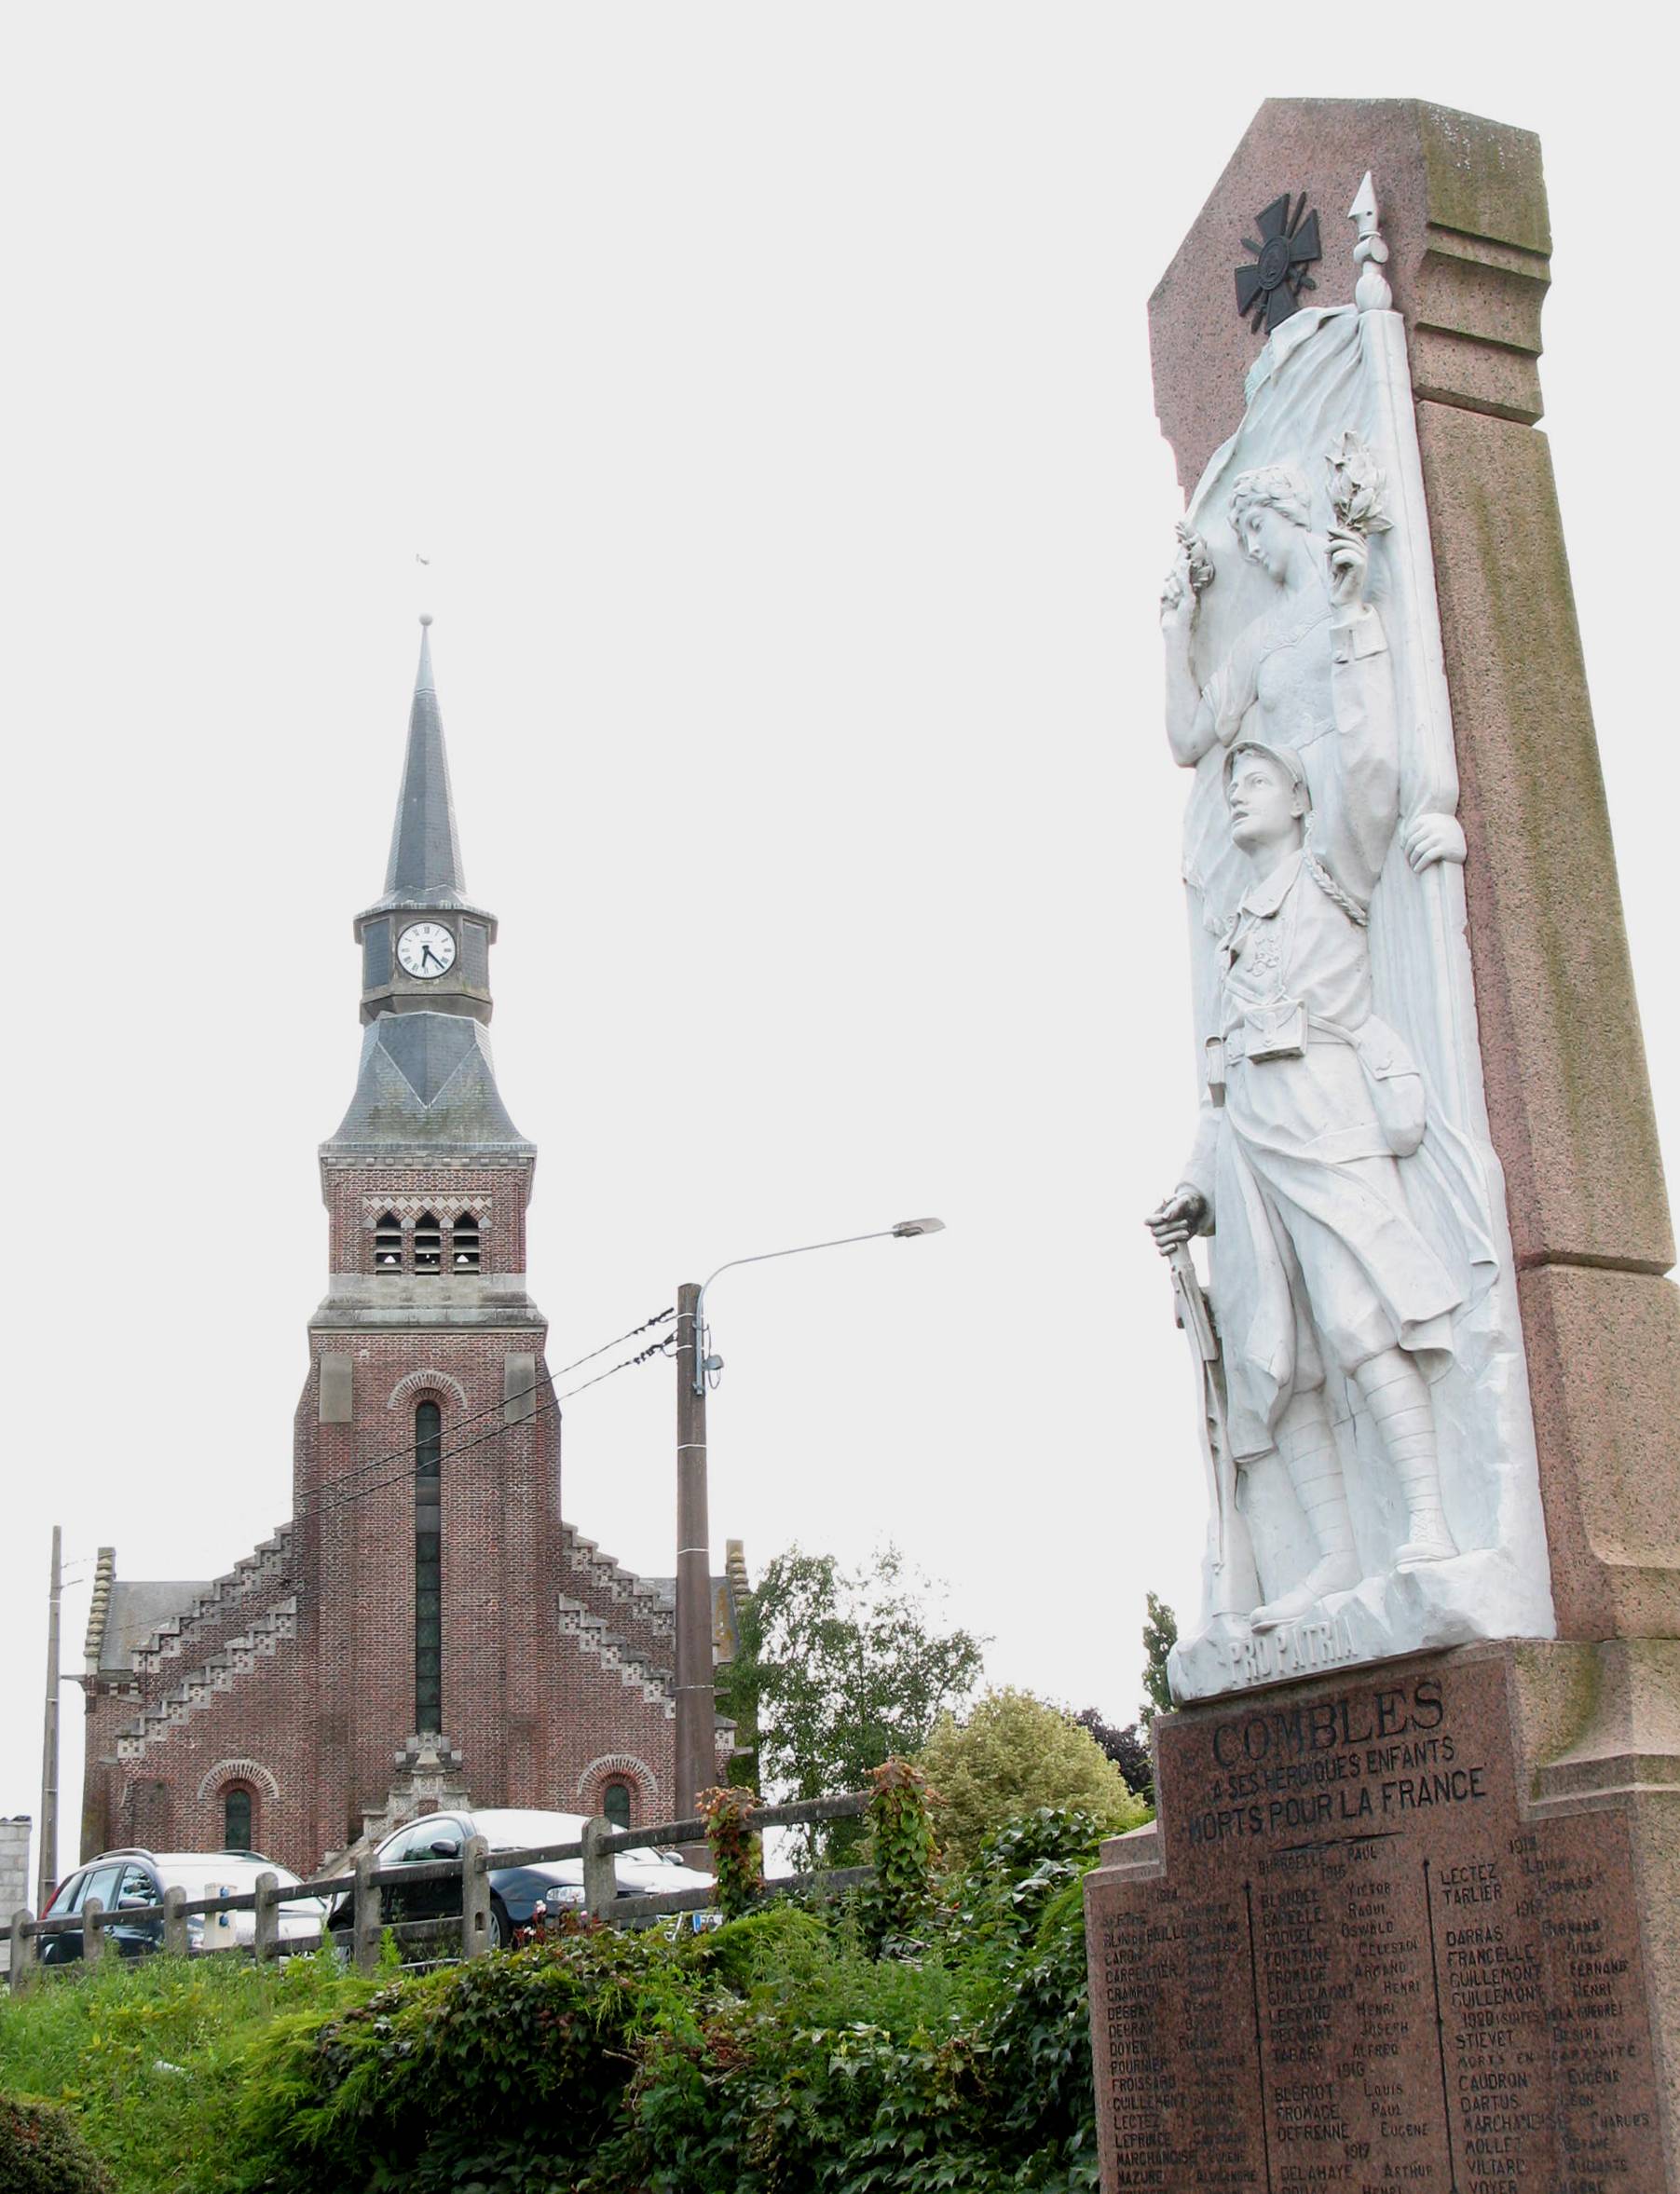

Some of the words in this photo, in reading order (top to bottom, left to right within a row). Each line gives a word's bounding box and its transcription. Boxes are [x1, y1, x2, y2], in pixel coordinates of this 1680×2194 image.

[1229, 1637, 1271, 1683] PRO
[1275, 1615, 1359, 1673] PATRIA
[1211, 1677, 1445, 1769] COMBLES
[1228, 1773, 1259, 1800] SES
[1367, 1735, 1455, 1775] ENFANTS
[1188, 1805, 1263, 1844] MORTS
[1269, 1792, 1332, 1831] POUR
[1341, 1786, 1374, 1819] LA
[1382, 1766, 1488, 1813] FRANCE
[1440, 1862, 1497, 1886] LECTEZ
[1442, 1884, 1504, 1905] TARLIER
[1342, 1921, 1395, 1938] OSWALD
[1446, 1925, 1505, 1947] DARRAS
[1450, 1963, 1542, 1989] GUILLEMONT
[1384, 1981, 1420, 1996] HENRI
[1357, 2001, 1396, 2017] HENRI
[1361, 2020, 1410, 2037] JOSEPH
[1363, 2078, 1404, 2097] LOUIS
[1458, 2071, 1530, 2092] CAUDRON
[1276, 2103, 1341, 2121] FROMAGE
[1372, 2102, 1403, 2118] PAUL
[1460, 2092, 1521, 2113] DARTUS
[1280, 2164, 1354, 2181] DELAHAYE
